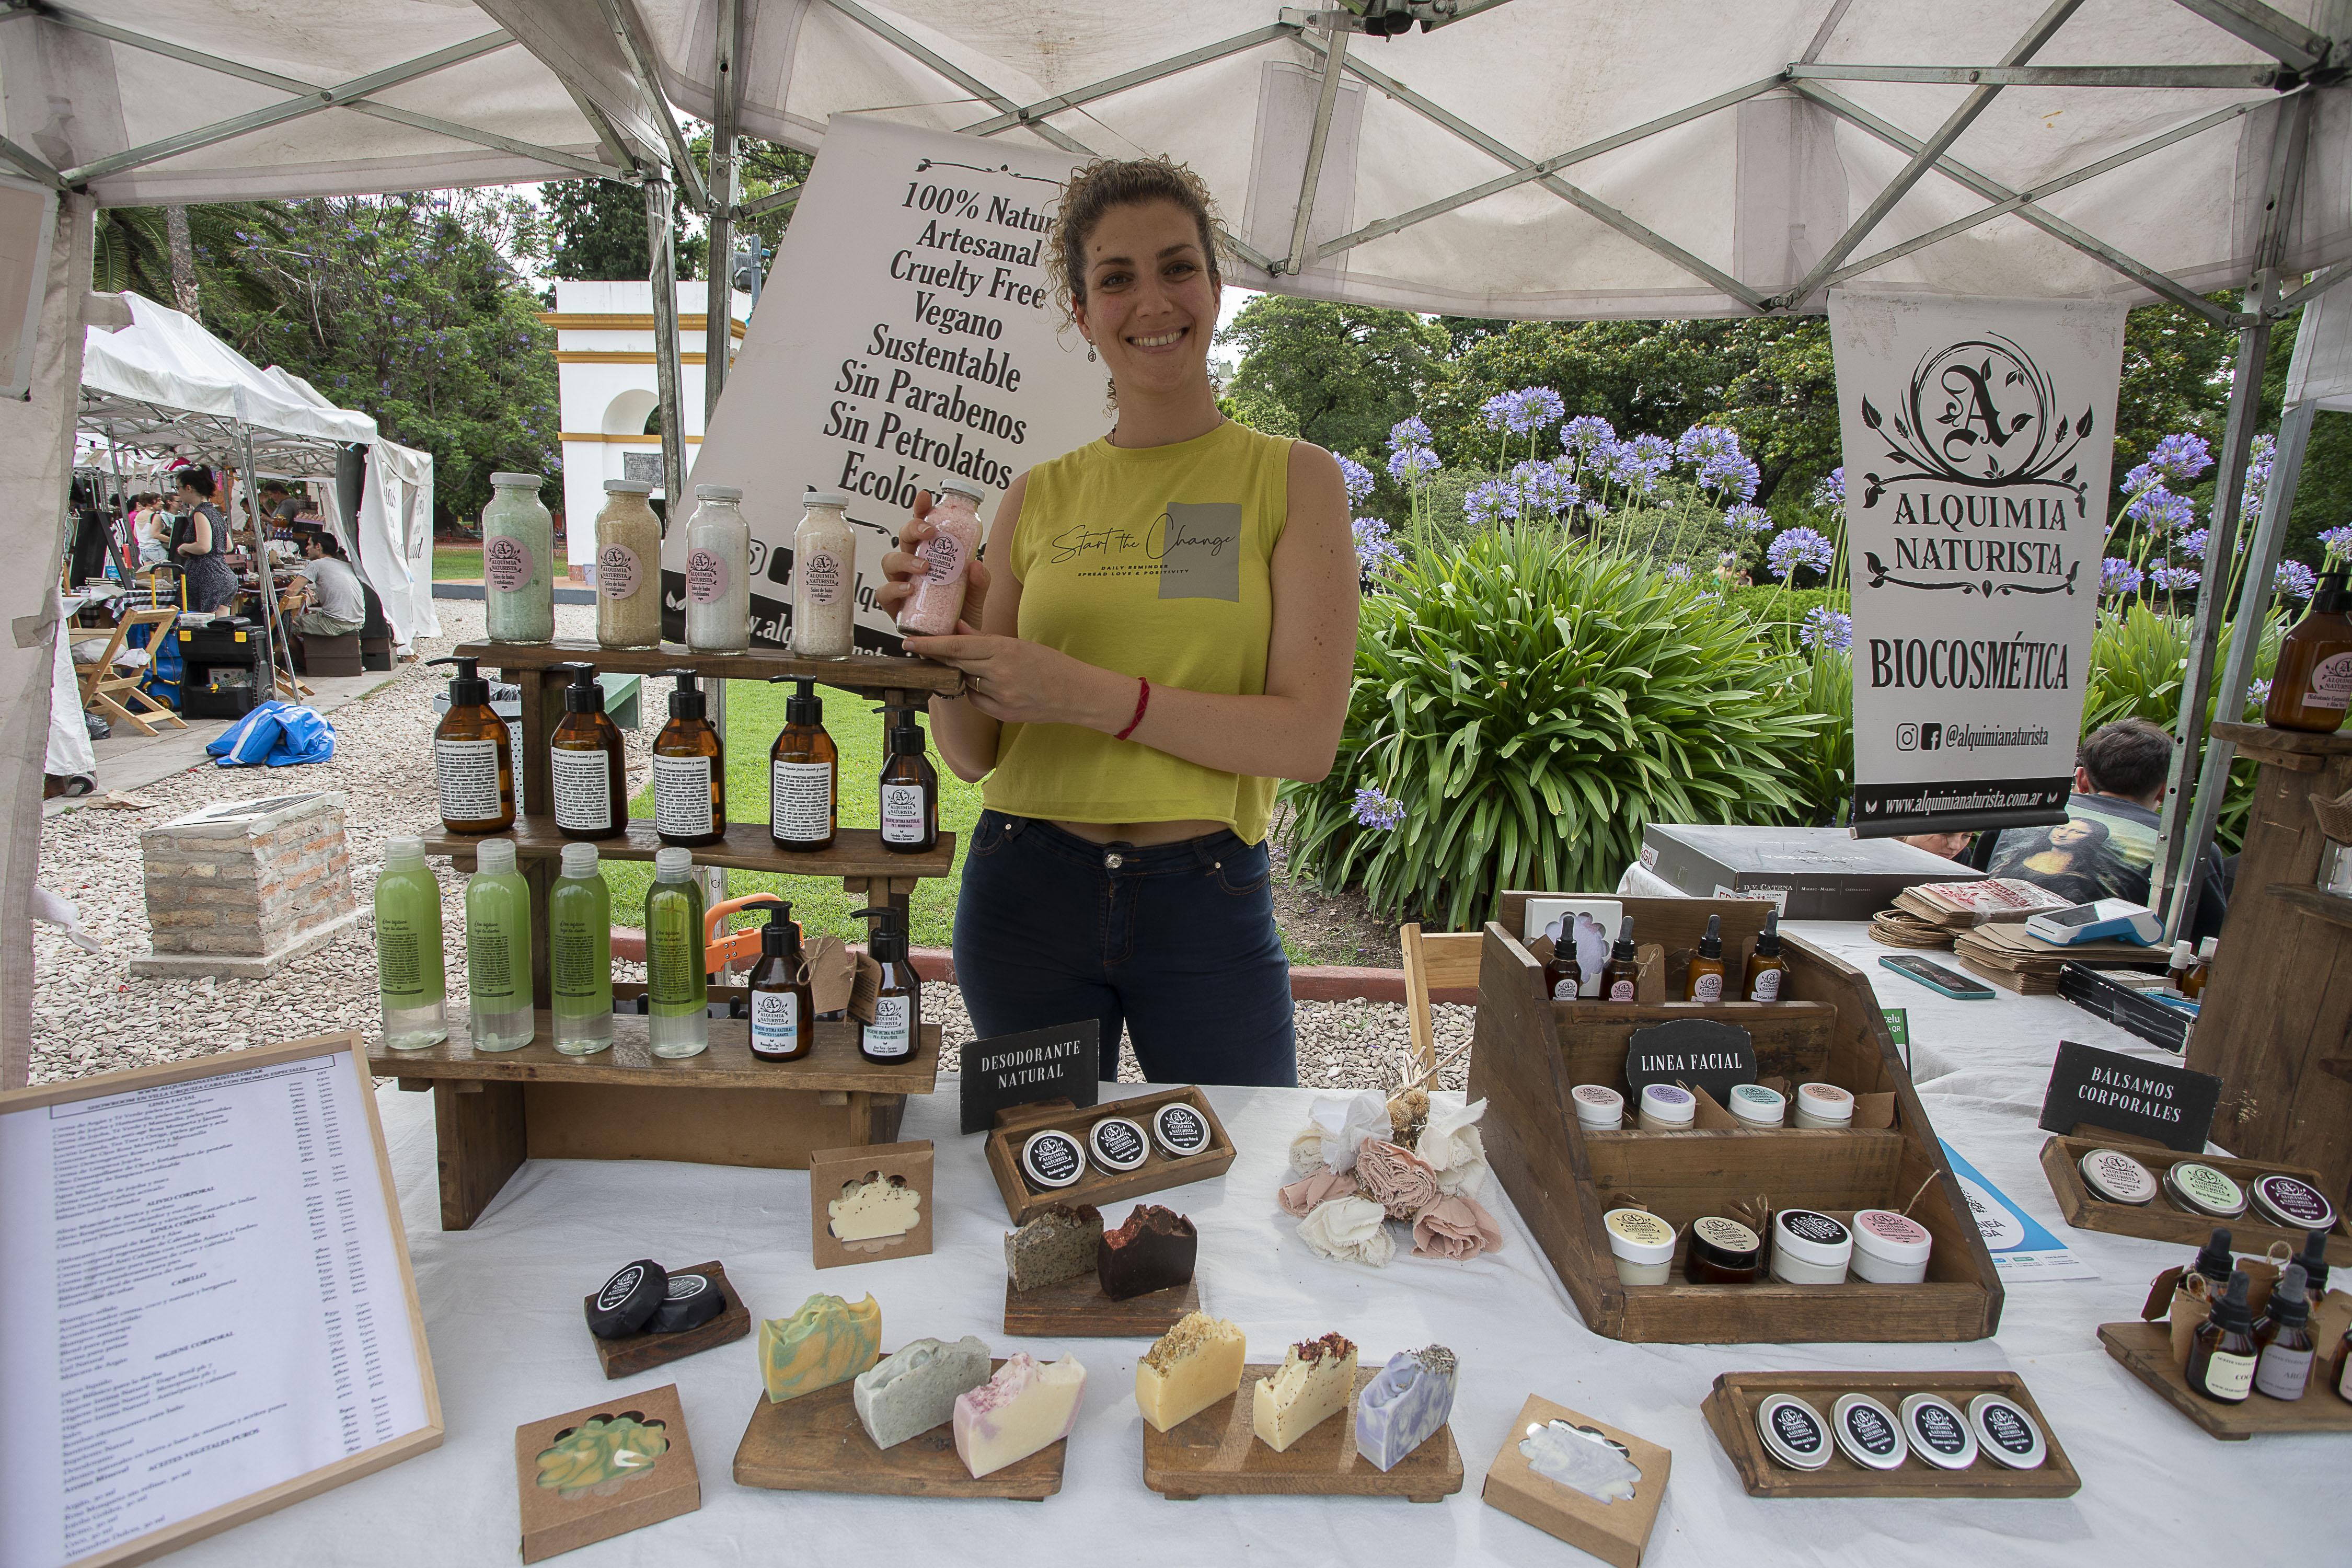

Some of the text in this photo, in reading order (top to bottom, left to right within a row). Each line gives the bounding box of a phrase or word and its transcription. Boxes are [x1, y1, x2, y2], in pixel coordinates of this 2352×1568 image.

[902, 182, 980, 220] 100%
[916, 219, 1043, 267] Artesanal
[890, 249, 1046, 309] Cruelty Free
[915, 290, 1002, 340] Vegano
[867, 323, 1021, 392] Sustentable
[834, 359, 1027, 444] Sin Parabenos
[823, 400, 1013, 490] Sin Petrolatos
[1893, 493, 2068, 532] ALQUIMIA
[1052, 513, 1236, 563] Start the Change
[926, 557, 951, 568] NATURISTA
[927, 552, 952, 562] ALQUIMIA
[1893, 537, 2063, 575] NATURISTA
[1869, 631, 2068, 690] BIOCOSMÉTICA
[1945, 723, 2049, 752] @alquimianaturista
[1886, 789, 2043, 815] www.alquimianaturista.com.ar
[982, 1040, 1080, 1071] DESODORANTE
[1642, 1053, 1742, 1071] LINEA FACIAL
[240, 1074, 270, 1082] PROMOS
[270, 1066, 307, 1077] ESPECIALES
[998, 1064, 1063, 1089] NATURAL
[2091, 1066, 2174, 1099] BÁLSAMOS
[2078, 1085, 2182, 1122] CORPORALES
[1043, 1151, 1066, 1162] ALQUIMIA
[1110, 1135, 1129, 1147] ALQUIMIA
[1112, 1139, 1133, 1151] NATURISTA
[1044, 1155, 1068, 1166] NATURISTA
[2105, 1168, 2135, 1177] ALQUIMIA
[2106, 1172, 2136, 1181] NATURISTA
